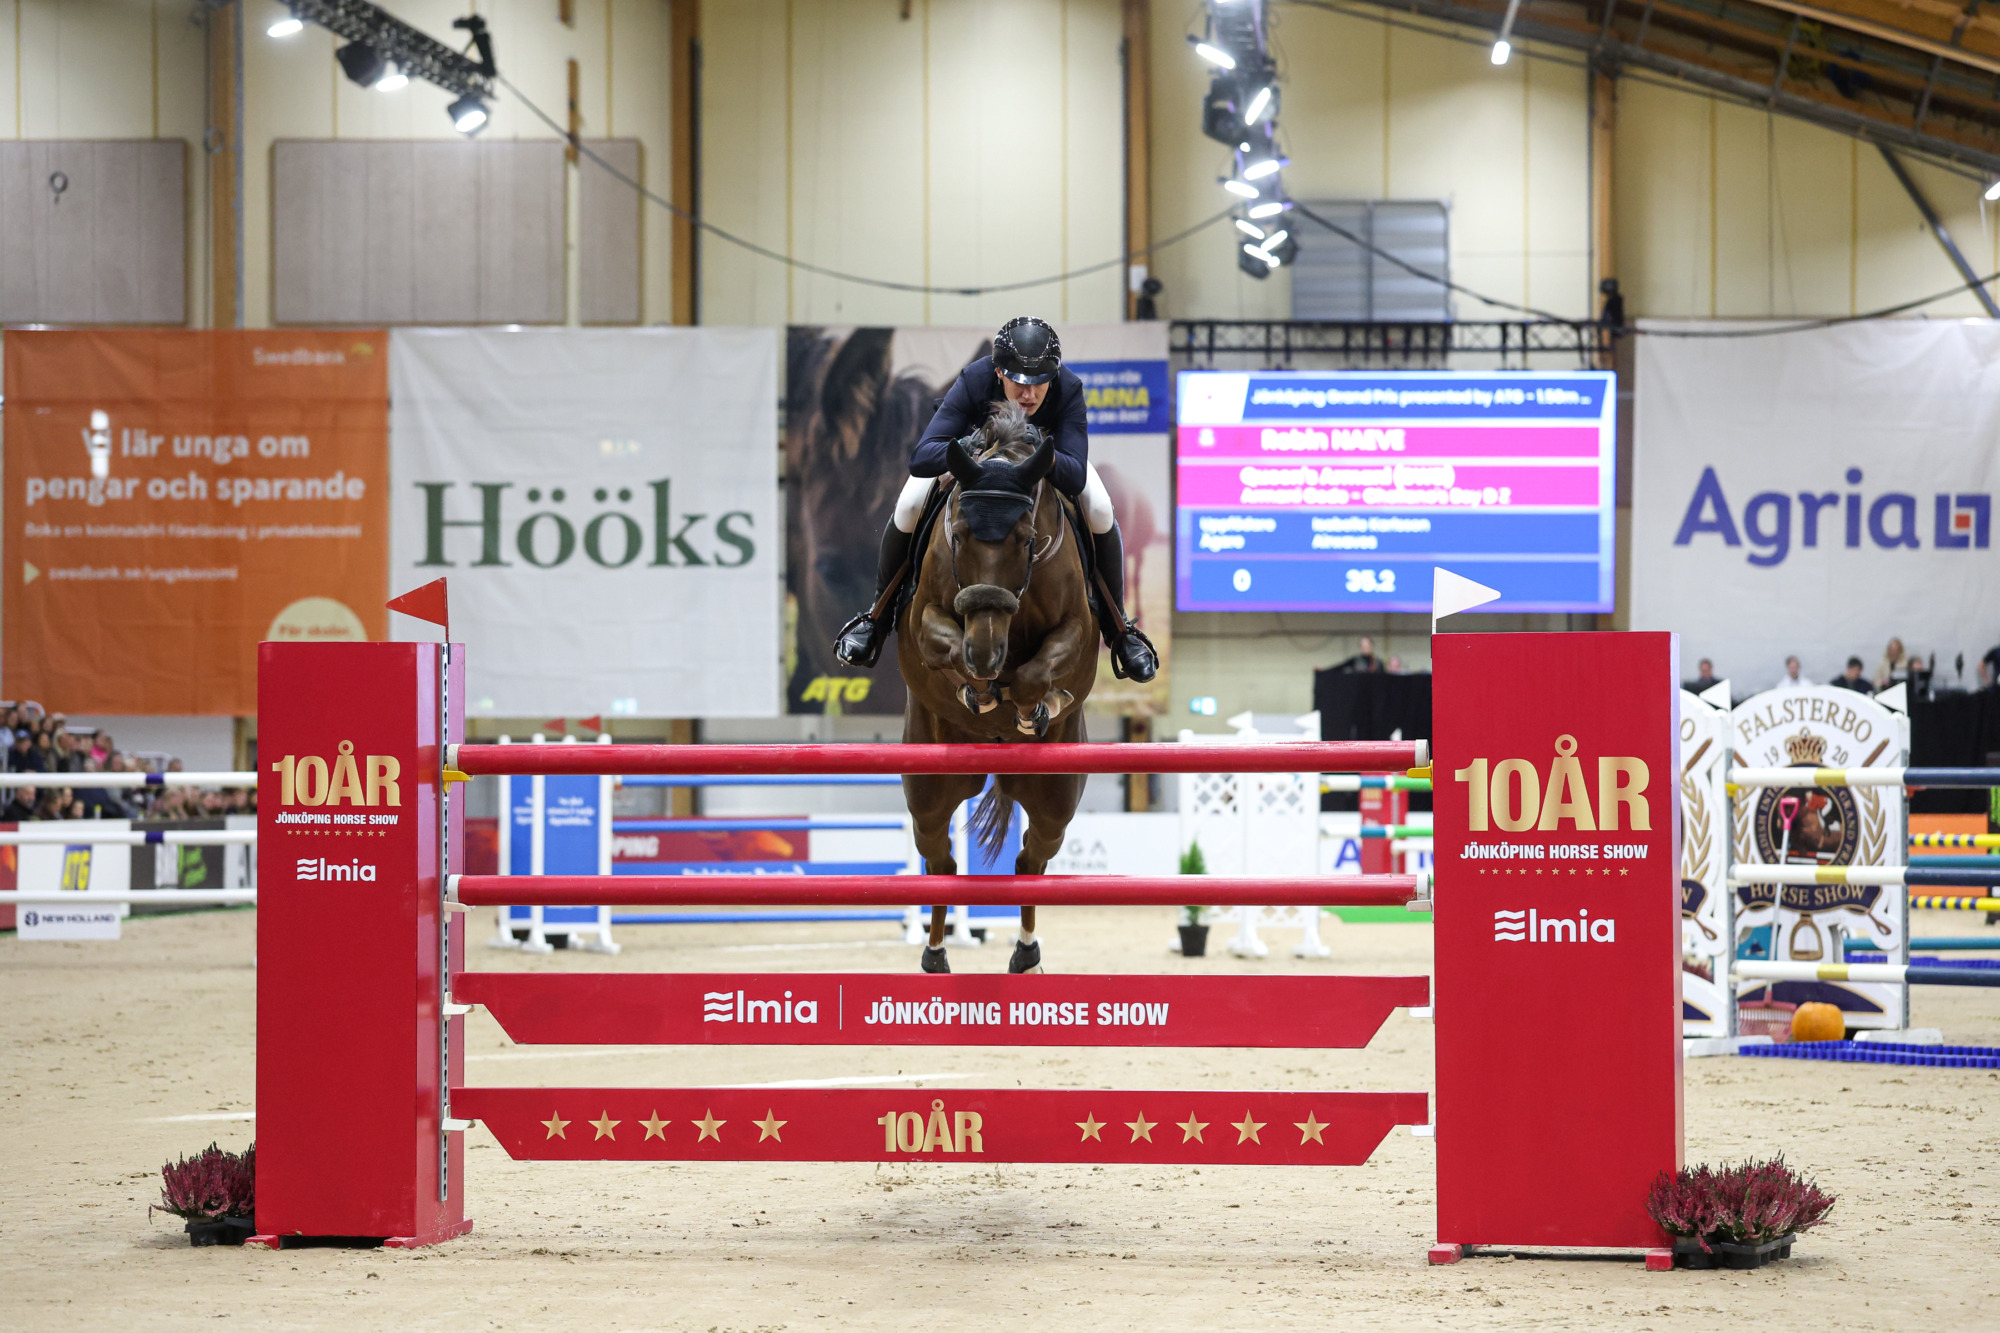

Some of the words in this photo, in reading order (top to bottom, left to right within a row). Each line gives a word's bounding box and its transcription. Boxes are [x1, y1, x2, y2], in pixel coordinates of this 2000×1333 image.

[253, 348, 346, 365] Swedbank
[1083, 387, 1149, 408] ARNA
[121, 428, 164, 458] lär
[173, 435, 249, 465] unga
[258, 435, 310, 458] om
[1261, 428, 1329, 451] Robin
[26, 477, 139, 507] pengar
[147, 470, 207, 500] och
[217, 470, 366, 507] sparande
[413, 478, 757, 568] Hööks
[1673, 465, 1920, 568] Agria
[1233, 569, 1251, 592] 0
[801, 676, 872, 702] ATG
[1738, 698, 1872, 744] FALSTERBO
[1764, 746, 1780, 766] 19
[1832, 746, 1848, 765] 20
[275, 811, 331, 824] JÖNKÖPING
[333, 814, 367, 825] HORSE
[368, 814, 399, 825] SHOW
[1460, 841, 1545, 859] JÖNKÖPING
[1549, 844, 1599, 859] HORSE
[1602, 844, 1649, 859] SHOW
[1750, 883, 1810, 906] HORSE
[1813, 884, 1866, 906] SHOW
[42, 914, 65, 923] NEW
[67, 914, 116, 923] HOLLAND
[864, 996, 1001, 1025] JÖNKÖPING
[1009, 1001, 1089, 1026] HORSE
[1096, 1002, 1170, 1026] SHOW
